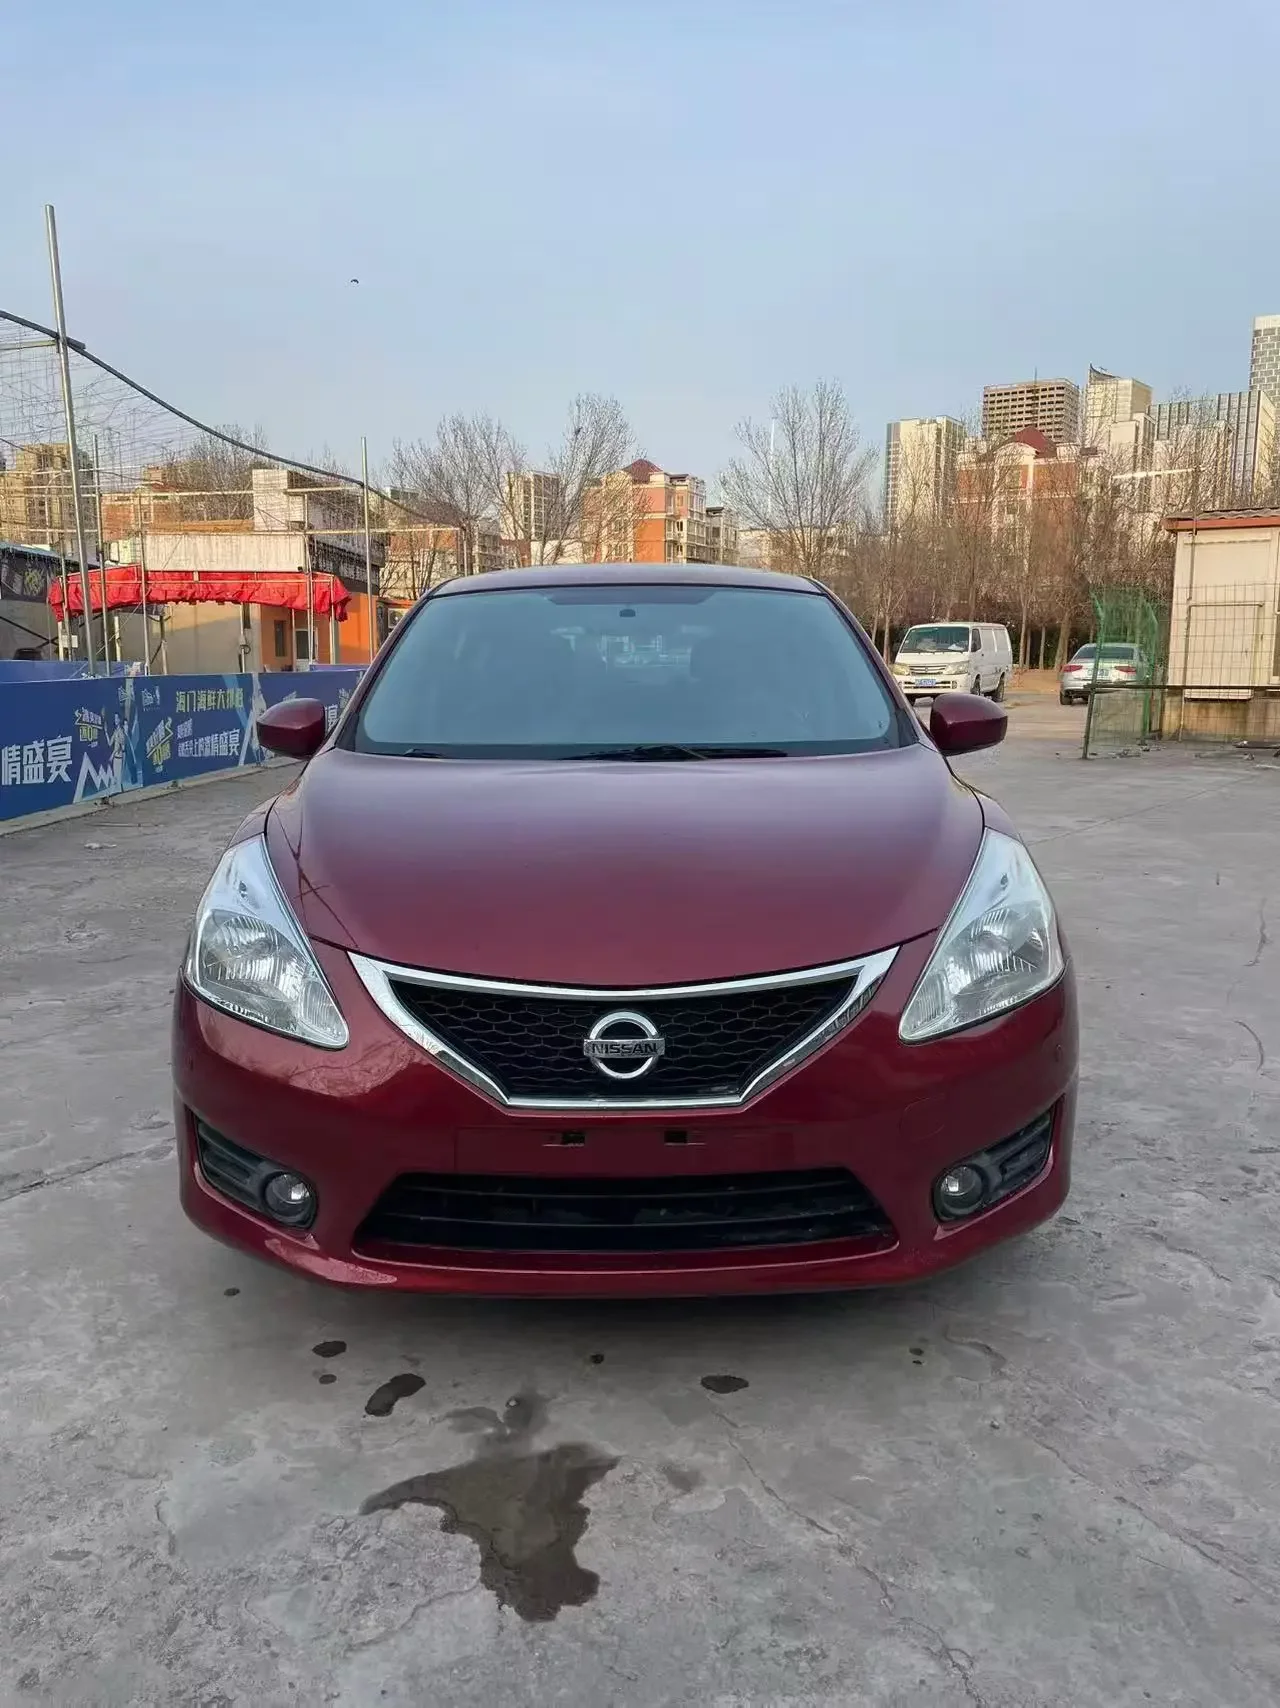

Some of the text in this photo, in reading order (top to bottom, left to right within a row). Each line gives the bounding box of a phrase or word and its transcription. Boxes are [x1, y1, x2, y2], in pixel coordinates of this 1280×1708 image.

[1, 735, 73, 785] 情盛宴
[592, 1042, 658, 1054] NISSAN
